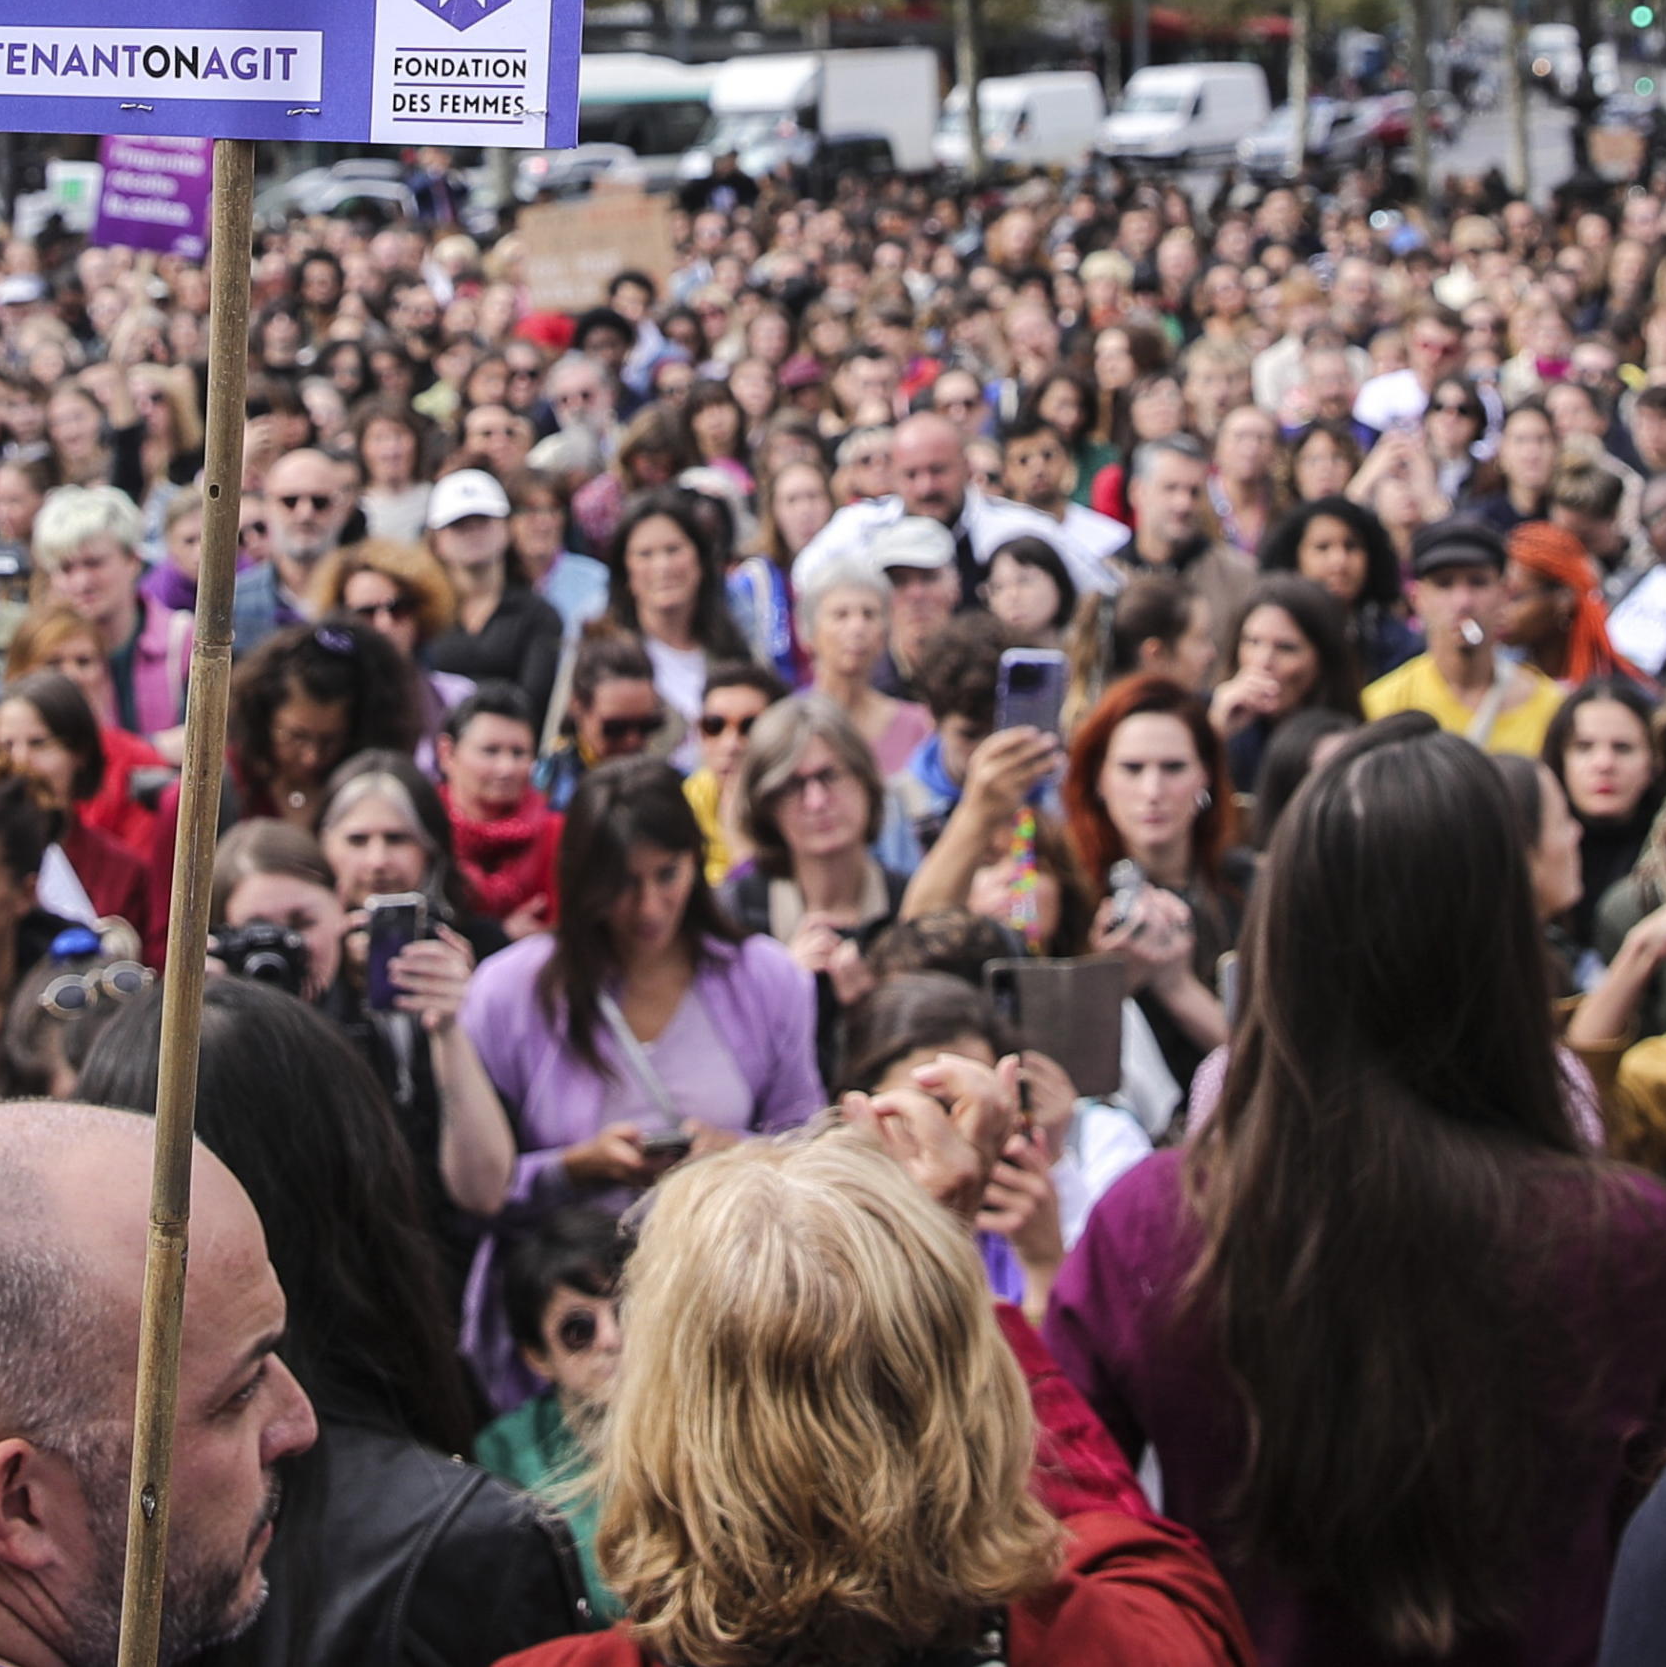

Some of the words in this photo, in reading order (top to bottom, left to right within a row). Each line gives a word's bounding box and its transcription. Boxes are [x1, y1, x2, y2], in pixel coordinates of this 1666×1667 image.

[393, 56, 528, 79] FONDATION
[391, 92, 432, 114] DES
[439, 94, 526, 116] FEMMES
